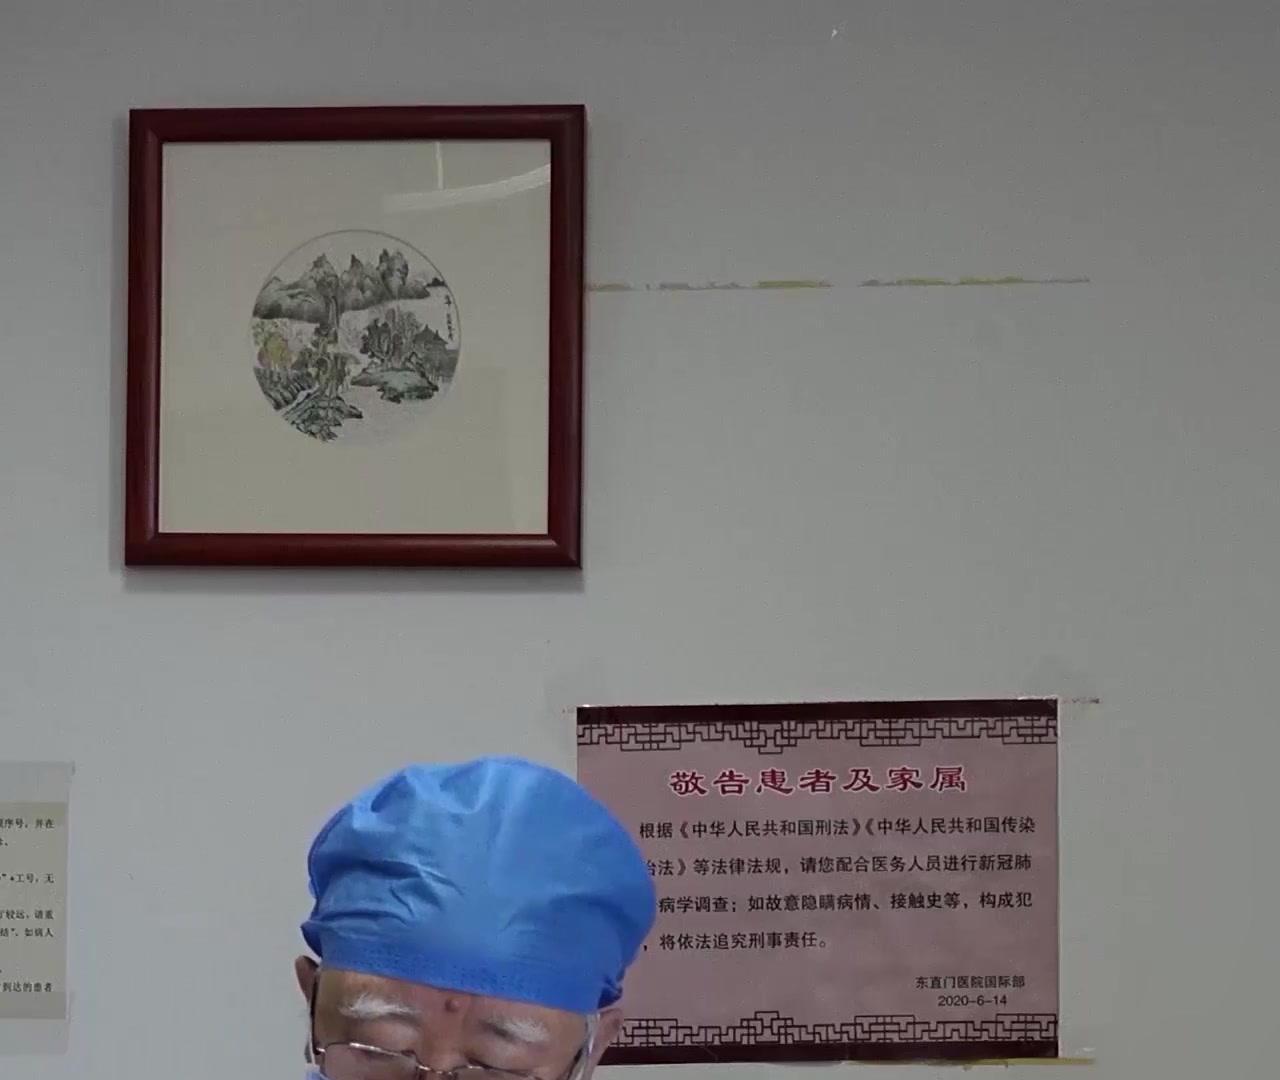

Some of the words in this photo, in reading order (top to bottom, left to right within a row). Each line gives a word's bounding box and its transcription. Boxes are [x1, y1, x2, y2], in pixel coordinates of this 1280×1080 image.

[668, 766, 969, 797] 敬告患者及家属
[639, 816, 1036, 839] 根据《中华人民共和国刑法》《中华人民共和国传染
[655, 891, 1033, 913] 病学调查；如故意隐瞒病情、接触史等，构成犯
[915, 975, 1026, 989] 东直门医院国际部
[938, 994, 1008, 1007] 2020-6-14
